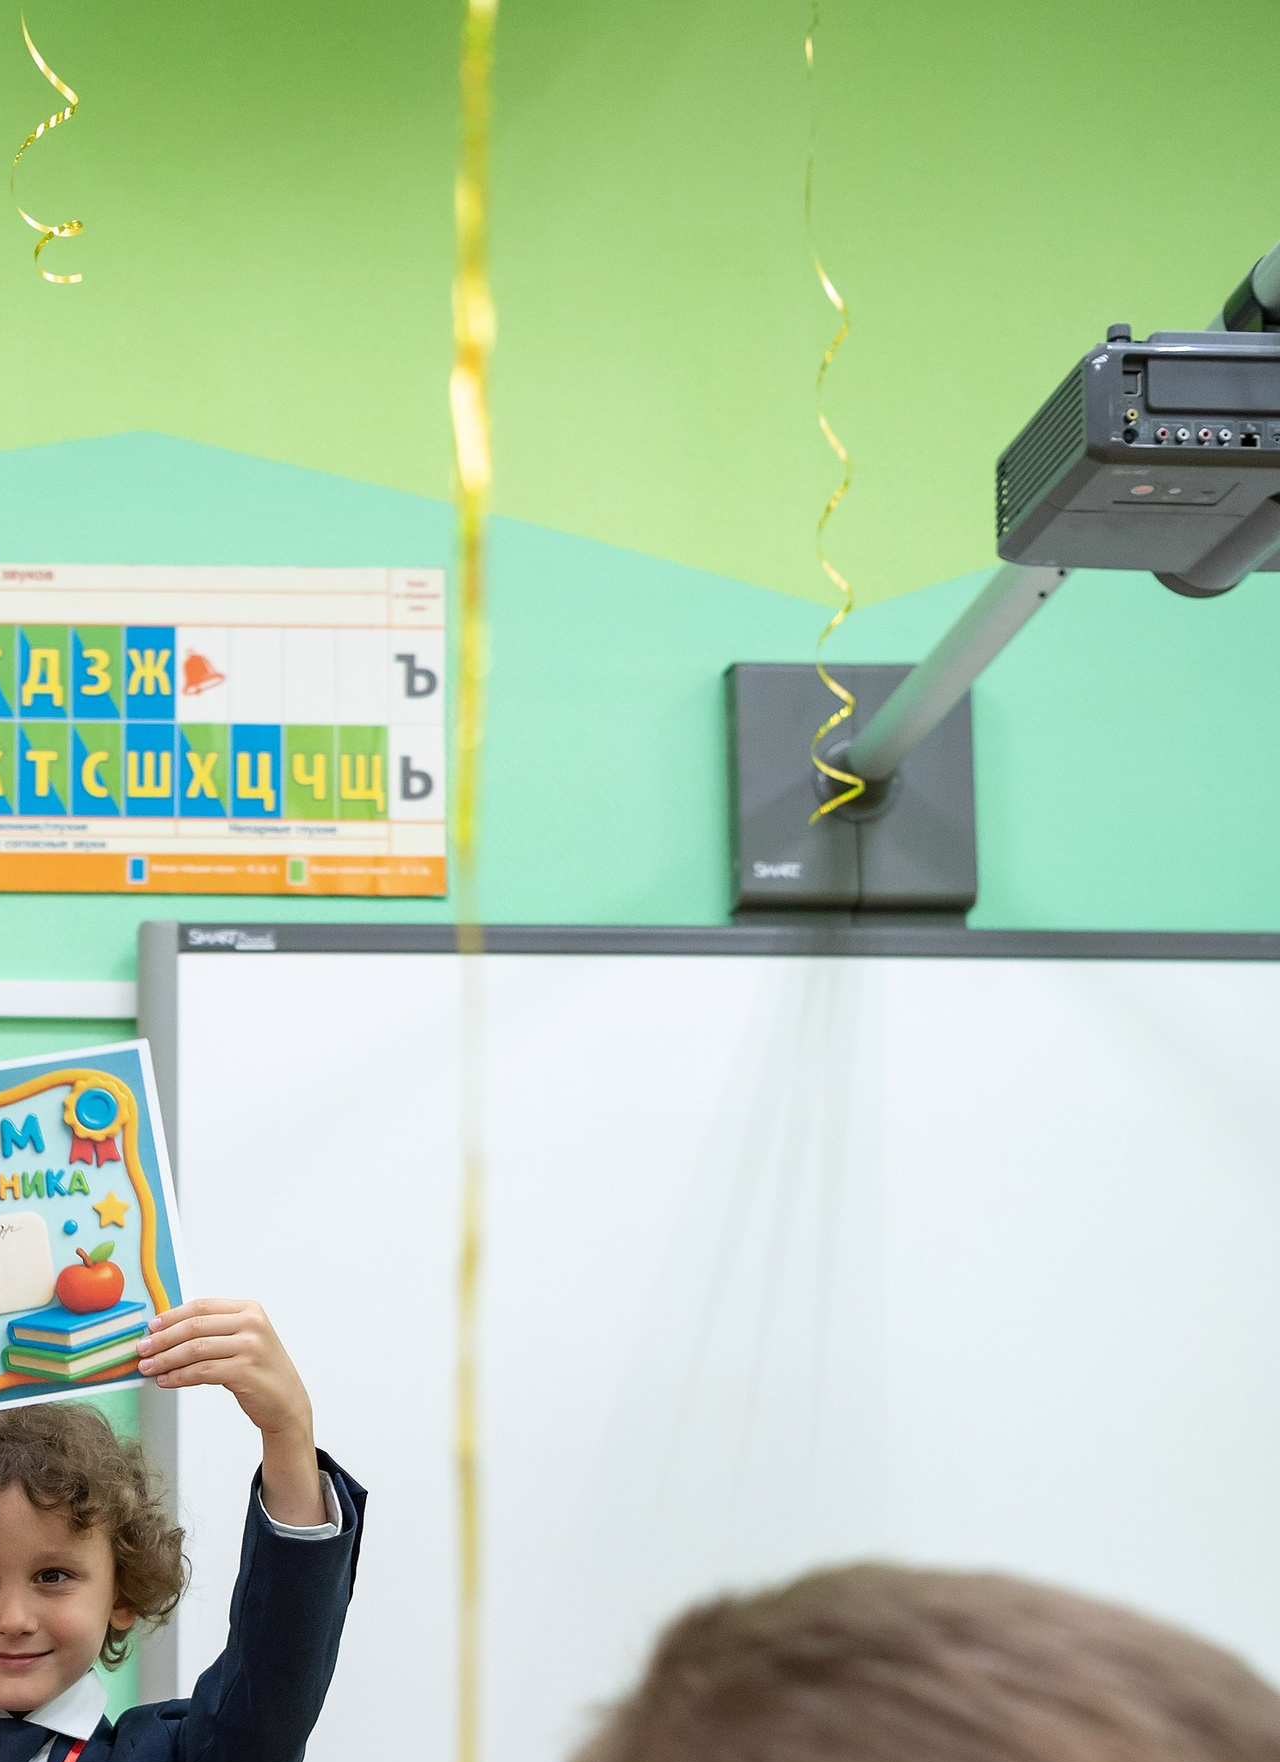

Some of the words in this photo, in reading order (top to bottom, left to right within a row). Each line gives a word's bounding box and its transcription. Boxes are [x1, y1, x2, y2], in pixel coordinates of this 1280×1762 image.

[22, 649, 63, 706] д
[128, 649, 171, 695] ж
[26, 751, 58, 797] т
[82, 751, 109, 798] с
[128, 752, 171, 797] ш
[237, 752, 276, 812] ц
[292, 754, 326, 800] ч
[340, 754, 386, 812] щ
